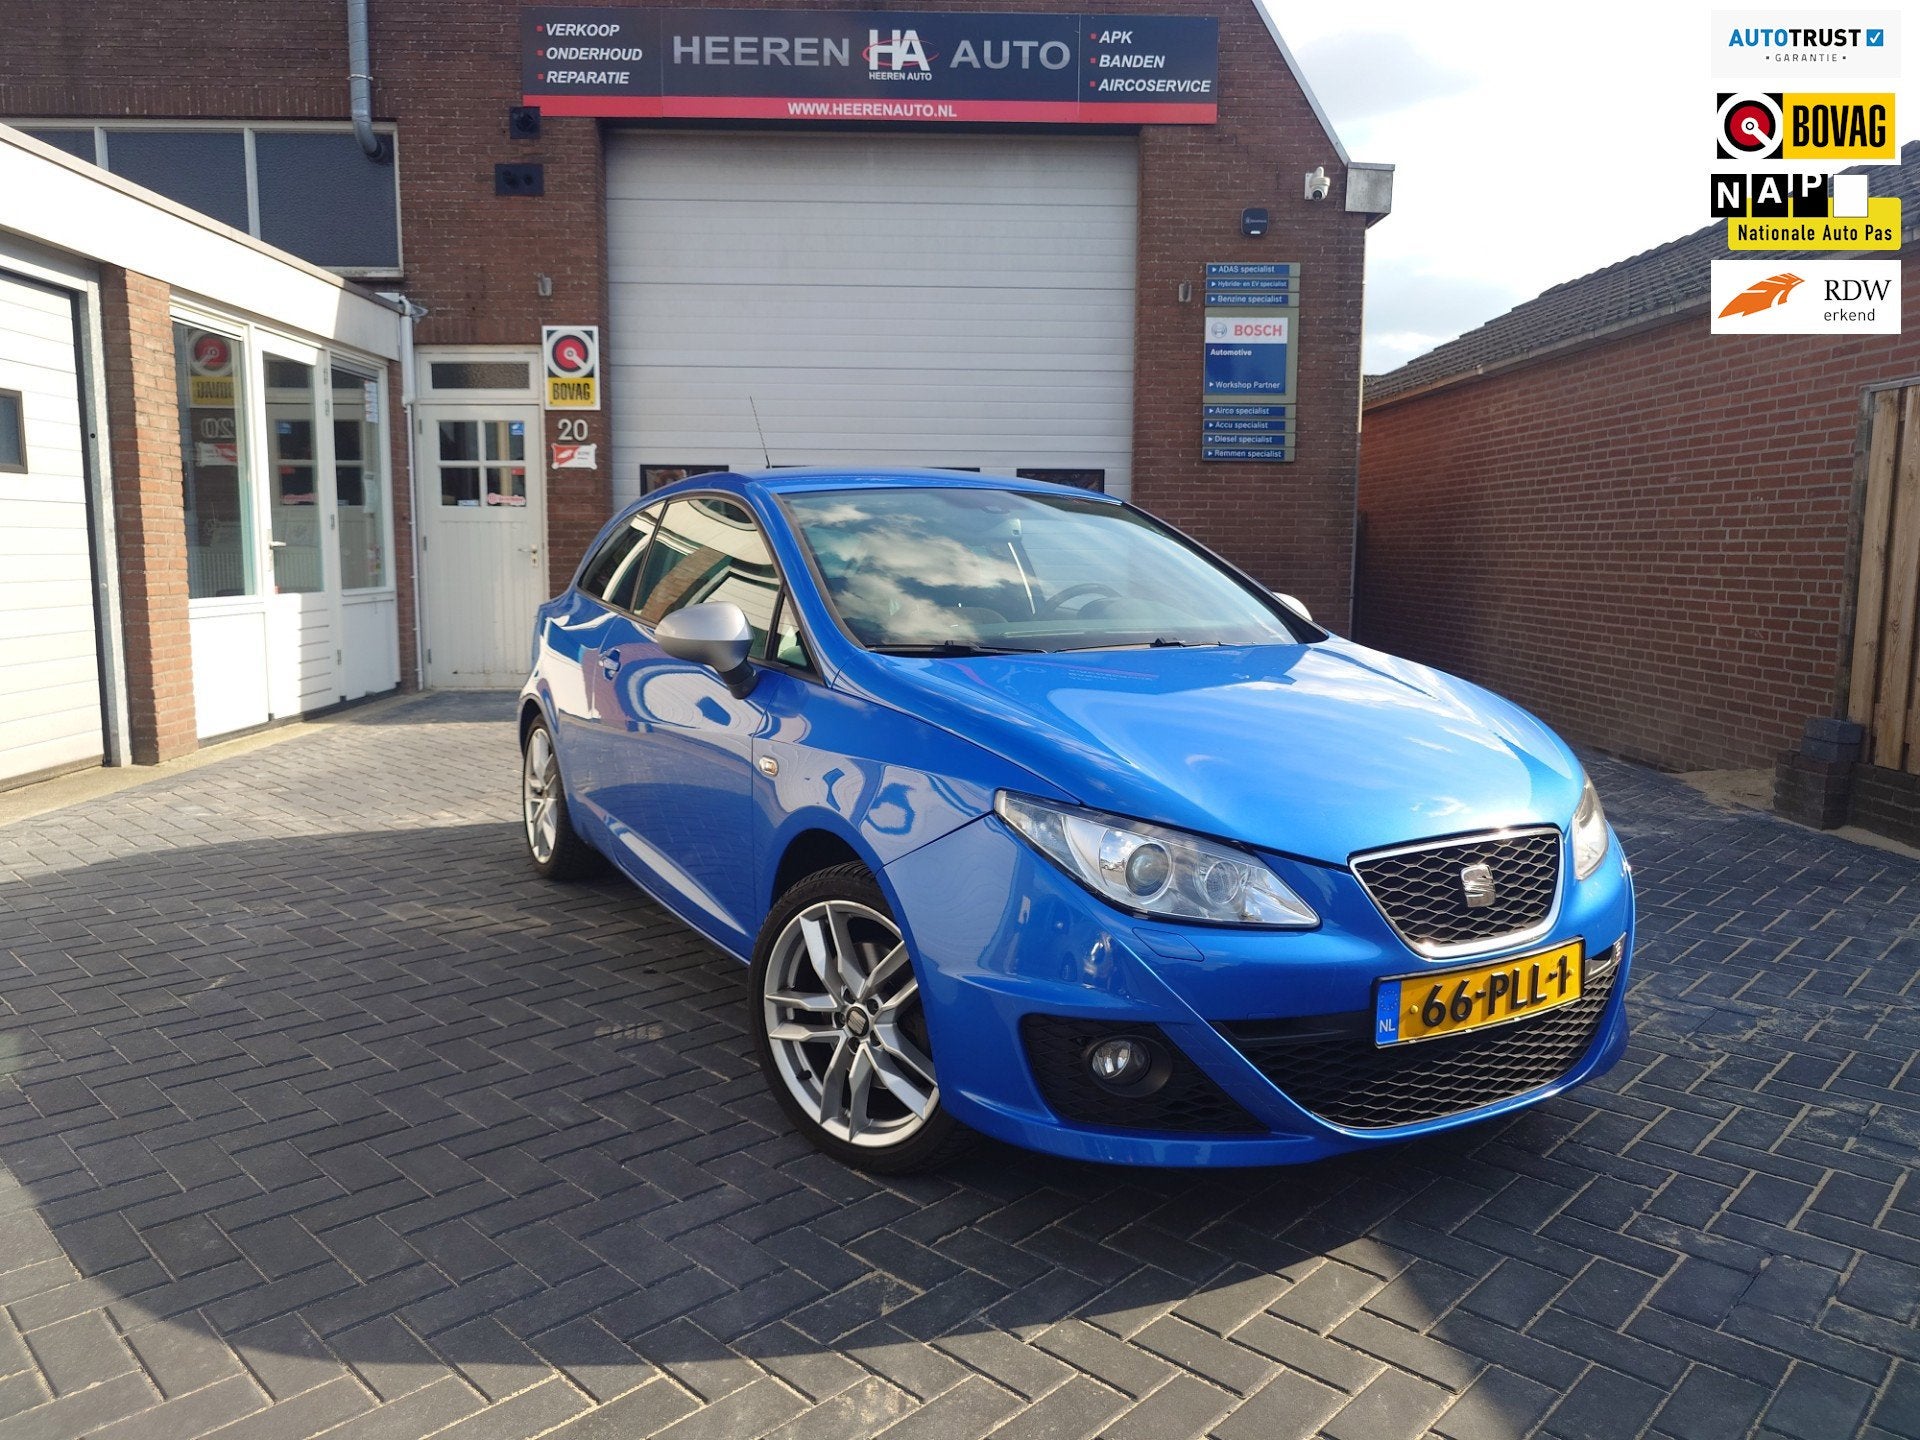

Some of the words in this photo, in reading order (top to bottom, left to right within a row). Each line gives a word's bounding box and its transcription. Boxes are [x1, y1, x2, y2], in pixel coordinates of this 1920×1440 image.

[546, 24, 620, 37] VERKOOP
[1099, 30, 1133, 44] APK
[546, 47, 643, 61] ONDERHOUD
[673, 35, 849, 67] HEEREN
[950, 40, 1071, 70] AUTO
[1099, 55, 1165, 69] BANDEN
[546, 71, 630, 85] REPARATIE
[868, 71, 906, 81] HEEREN
[907, 72, 932, 81] AUTO
[1098, 78, 1211, 93] AIRCOSERVICE
[787, 102, 957, 118] WWW.HEERENAUTO.NL
[1218, 265, 1239, 273] ADAS
[1240, 265, 1275, 275] specialist
[1260, 281, 1287, 289] specialist
[1217, 295, 1247, 303] Benzine
[1248, 295, 1282, 305] specialist
[1234, 324, 1283, 337] BOSCH
[1210, 348, 1253, 356] Automotive
[552, 382, 591, 401] BOVAG
[1215, 381, 1252, 390] Workshop
[1253, 381, 1280, 389] Partner
[1215, 406, 1234, 415] Airco
[1235, 407, 1270, 416] specialist
[557, 418, 589, 442] 20
[1215, 421, 1233, 429] Accu
[1234, 421, 1268, 431] specialist
[1214, 435, 1237, 443] Diesel
[1238, 436, 1273, 445] specialist
[1214, 449, 1246, 457] Remmen
[1247, 450, 1282, 459] specialist
[1421, 953, 1568, 1027] 66-PLL-1
[1379, 1018, 1396, 1033] NL
